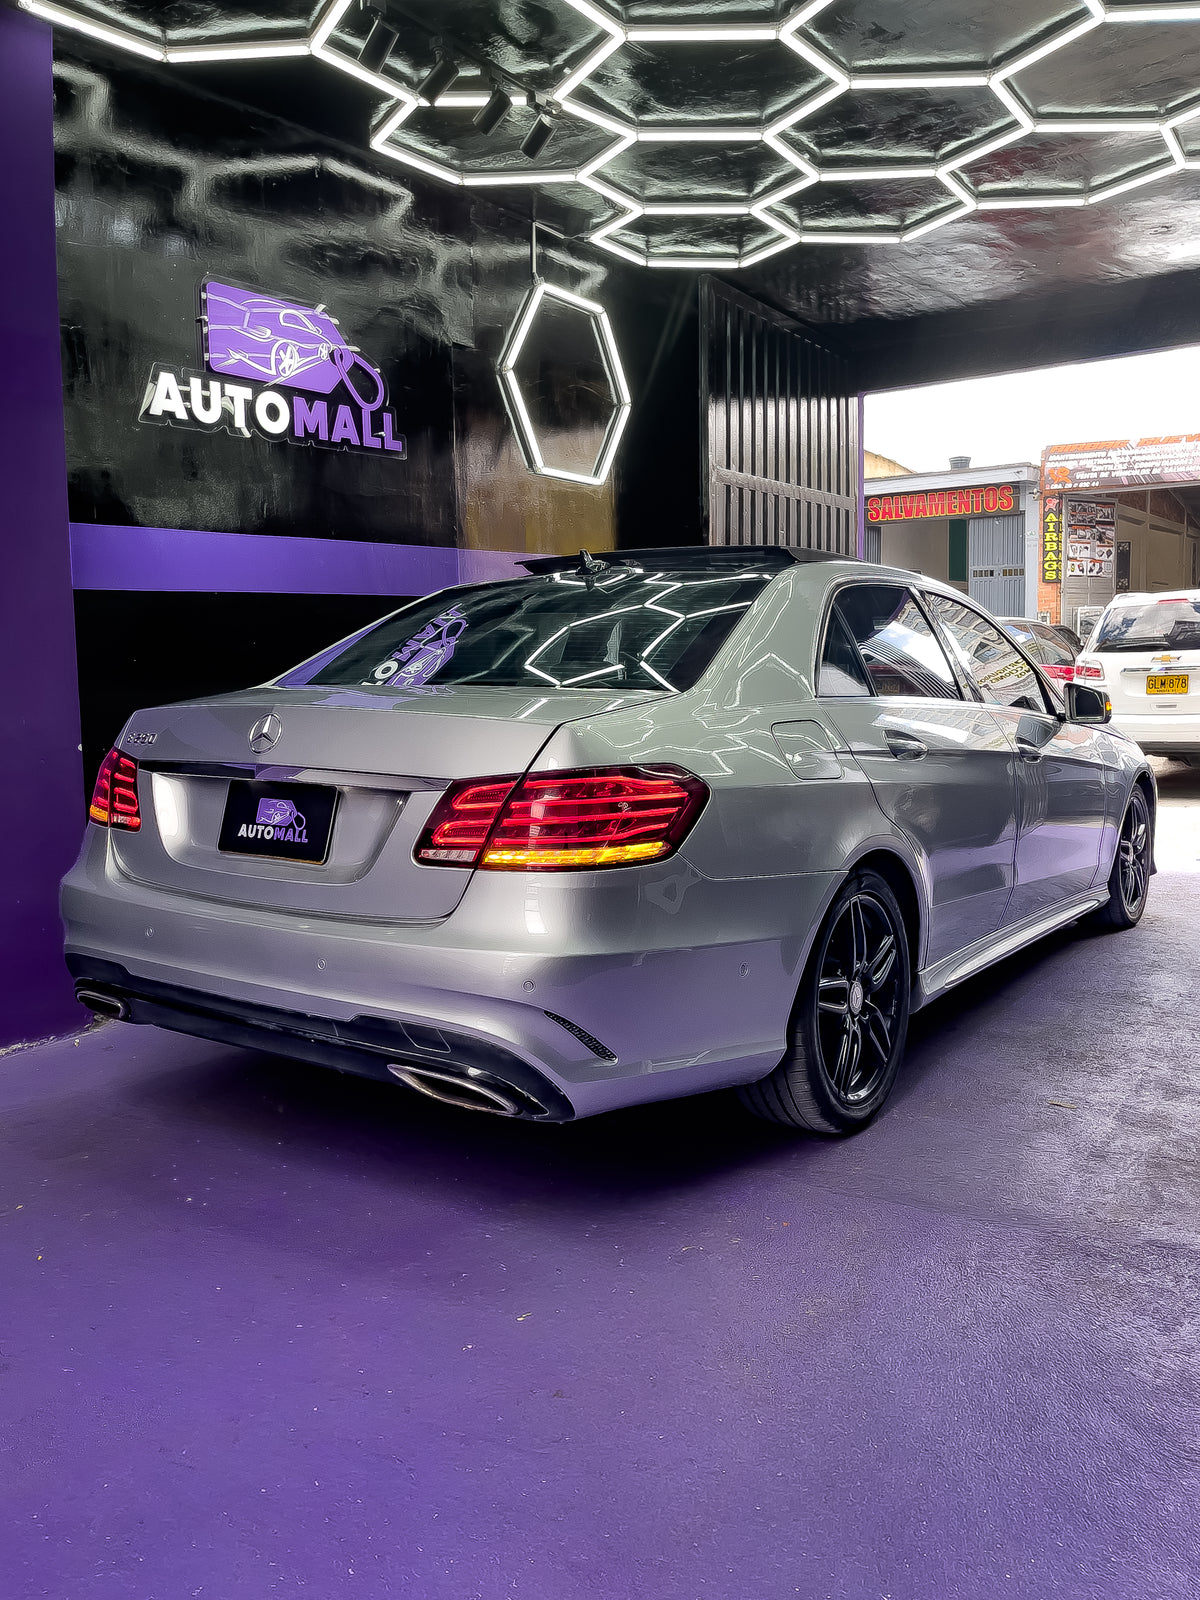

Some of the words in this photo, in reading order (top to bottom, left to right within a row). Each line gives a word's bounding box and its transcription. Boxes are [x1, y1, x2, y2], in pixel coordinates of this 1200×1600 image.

[149, 371, 403, 452] AUTOMALL
[867, 485, 1014, 522] SALVAMENTOS
[1044, 512, 1058, 580] AIRBAGS
[237, 823, 309, 844] AUTOMALL
